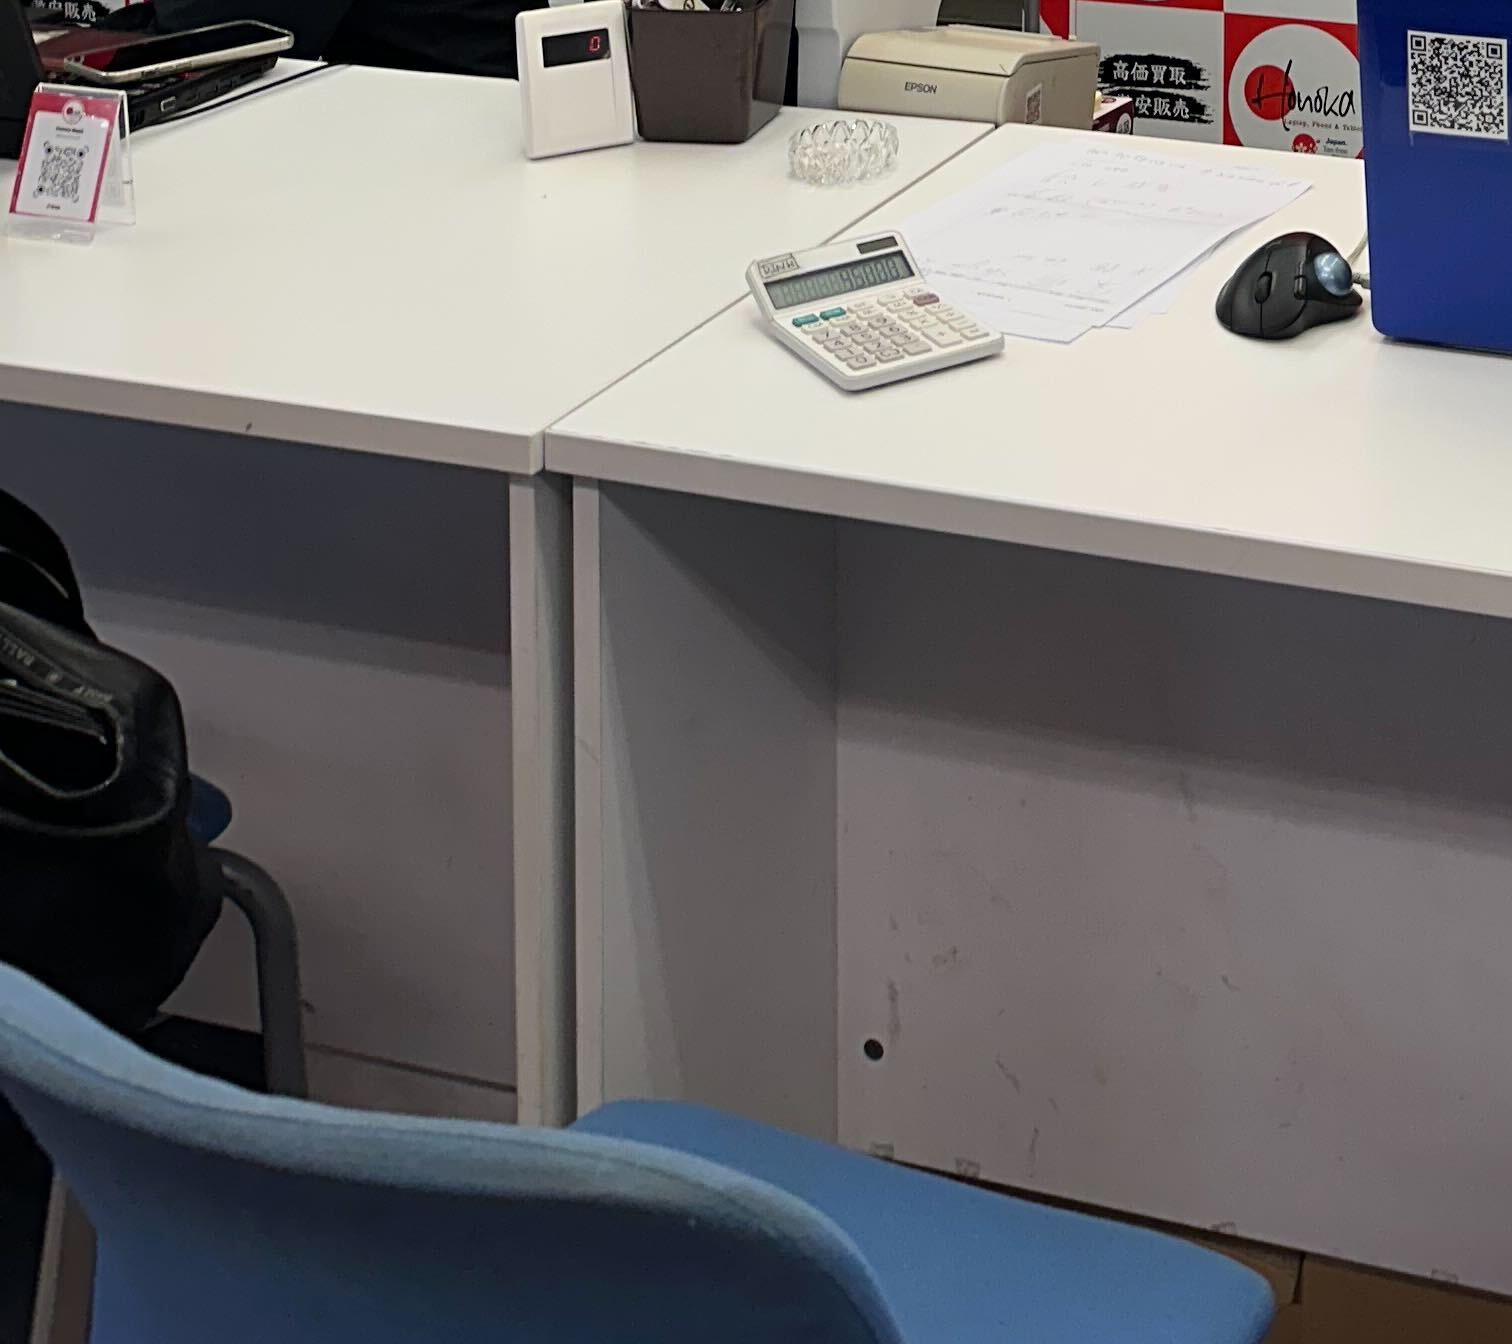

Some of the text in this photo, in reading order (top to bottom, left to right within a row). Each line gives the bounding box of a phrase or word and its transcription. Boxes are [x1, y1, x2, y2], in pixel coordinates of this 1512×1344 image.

[1112, 60, 1187, 86] 高価買取
[905, 82, 937, 94] EPSON
[1252, 59, 1355, 131] Honoka
[1117, 93, 1190, 119] 安販売
